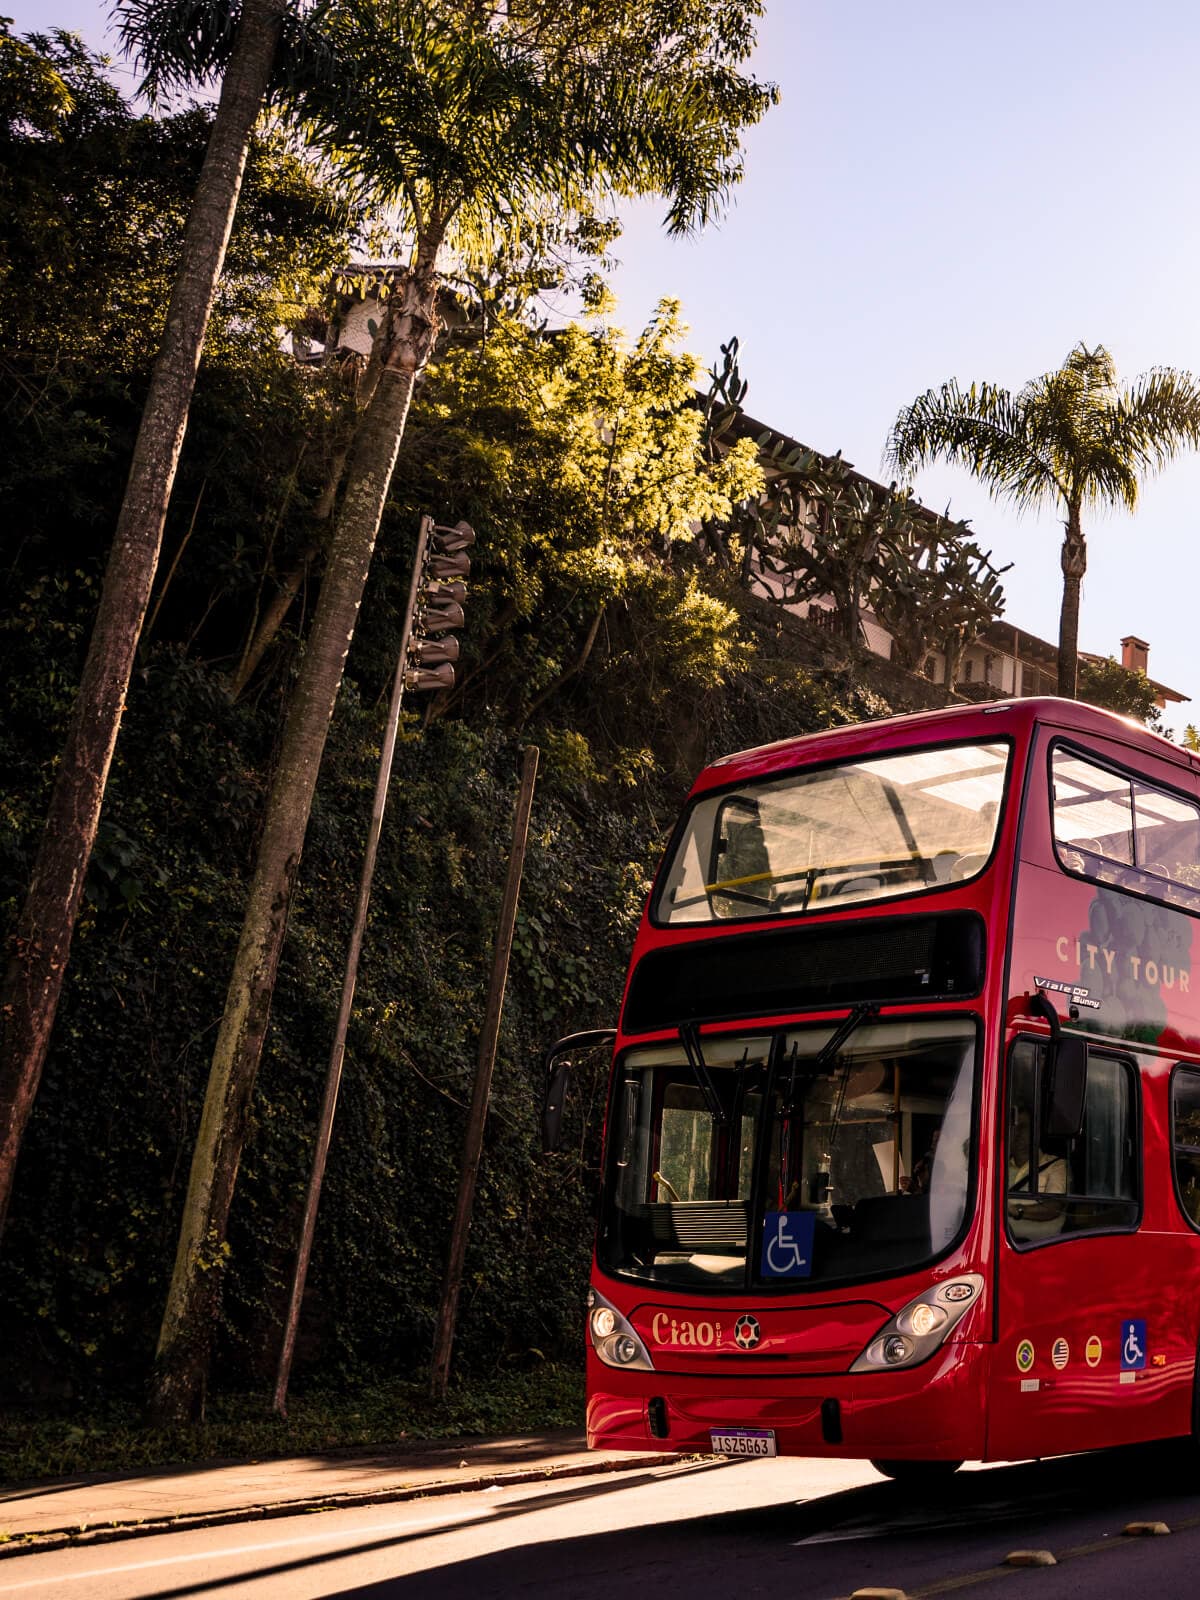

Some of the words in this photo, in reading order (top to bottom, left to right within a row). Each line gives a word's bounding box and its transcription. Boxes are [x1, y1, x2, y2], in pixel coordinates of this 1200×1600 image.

[1056, 936, 1116, 974] CITY
[1130, 955, 1190, 993] TOUR
[1034, 976, 1073, 995] Viale
[1072, 987, 1089, 997] DD
[1072, 994, 1101, 1009] Sunny
[652, 1312, 714, 1346] Ciao
[718, 1437, 768, 1455] ISZ5G63
